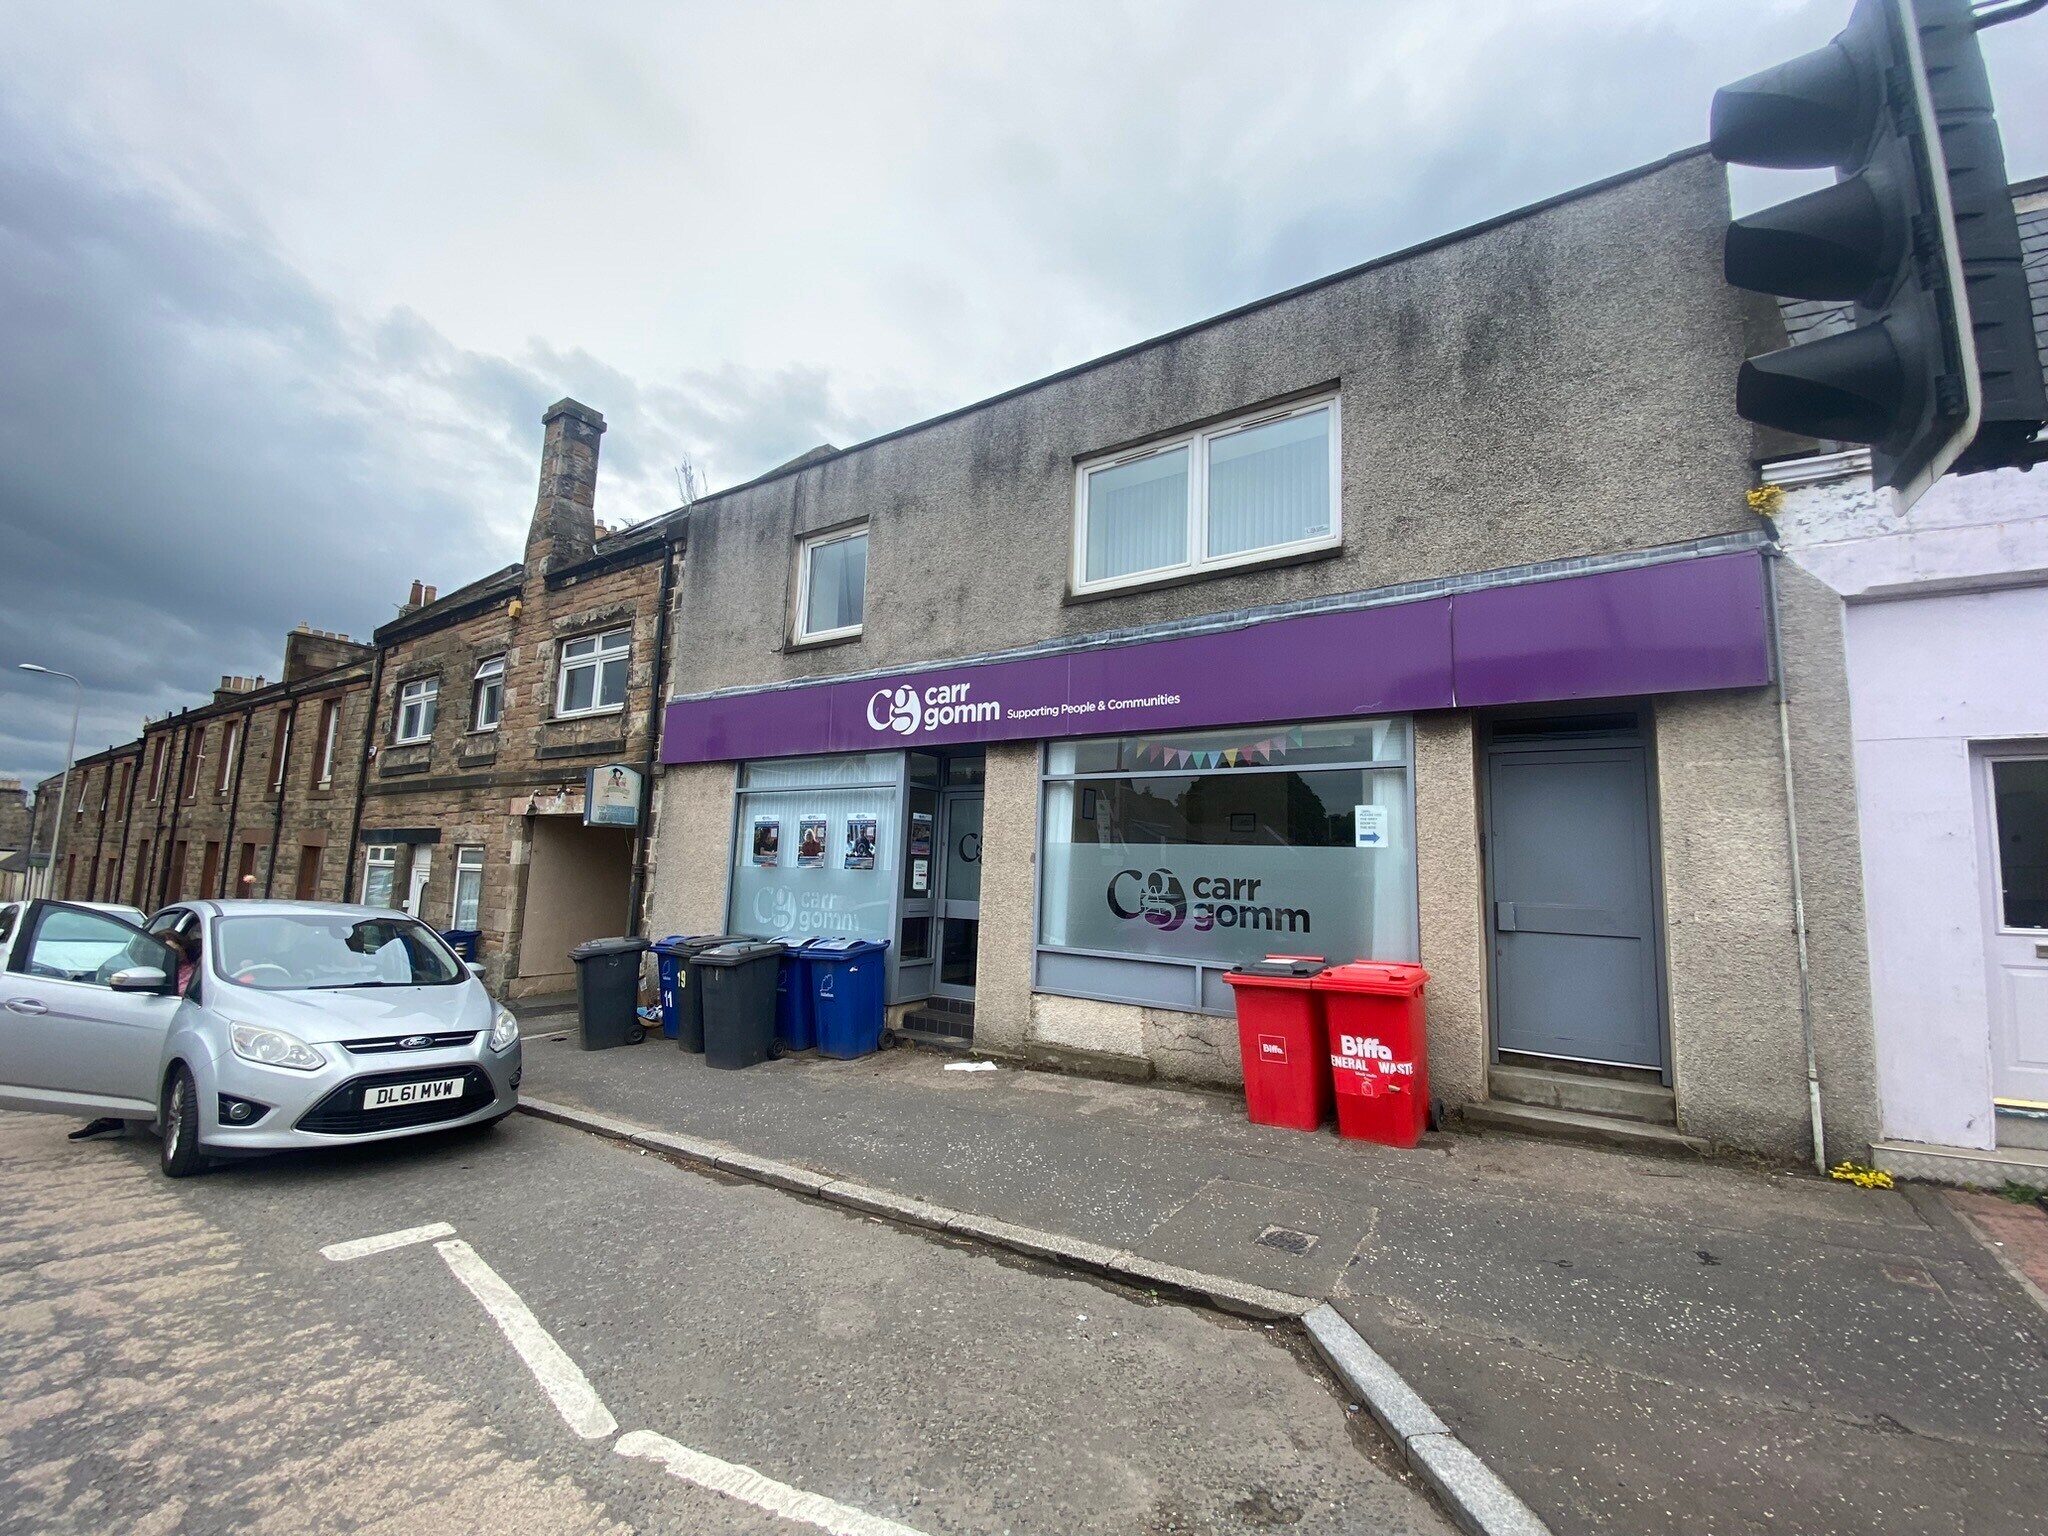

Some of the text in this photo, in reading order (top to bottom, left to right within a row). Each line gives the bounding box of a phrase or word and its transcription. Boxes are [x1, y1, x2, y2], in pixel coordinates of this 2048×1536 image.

[925, 683, 970, 705] carr
[924, 701, 1000, 731] gomm
[1007, 694, 1181, 720] Supporting People & Communities
[1193, 877, 1261, 901] carr
[800, 892, 837, 909] carr
[800, 911, 859, 932] gomm
[1193, 903, 1311, 933] gomm
[677, 970, 686, 988] 19
[664, 990, 673, 1008] 11
[408, 1036, 426, 1046] Ford
[1341, 1034, 1393, 1060] Biffa
[1330, 1054, 1369, 1072] ENERAL
[1378, 1061, 1414, 1076] WASTE
[376, 1081, 453, 1104] DL61 MVW
